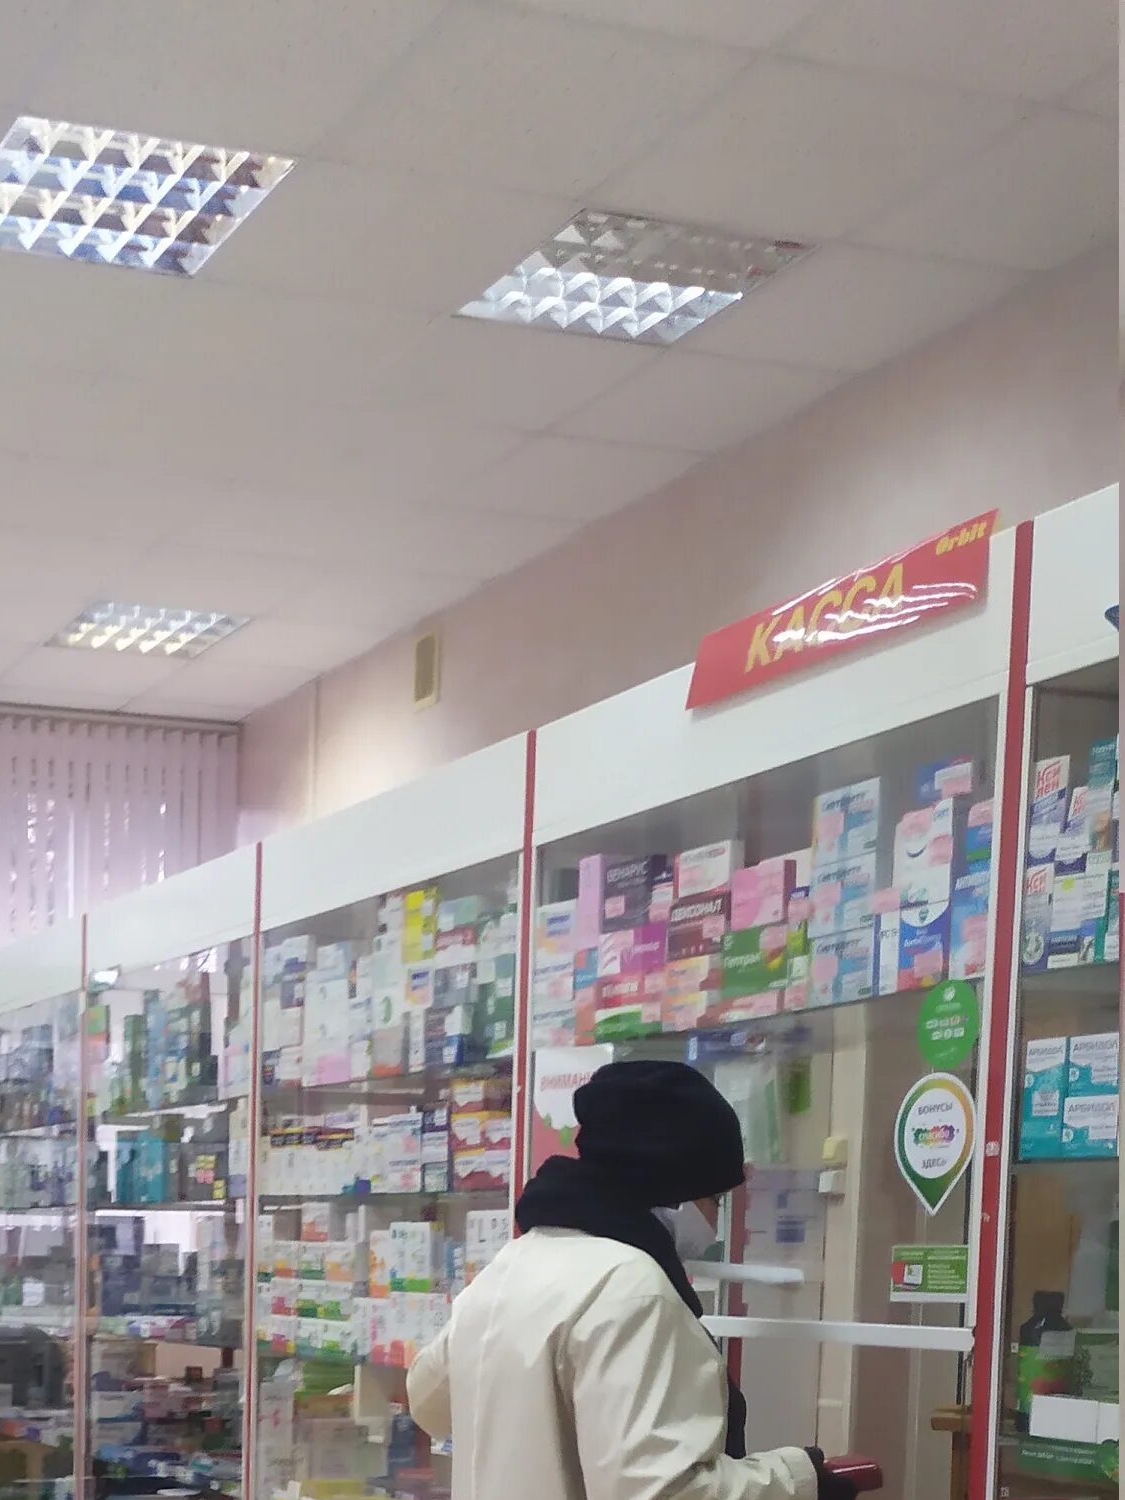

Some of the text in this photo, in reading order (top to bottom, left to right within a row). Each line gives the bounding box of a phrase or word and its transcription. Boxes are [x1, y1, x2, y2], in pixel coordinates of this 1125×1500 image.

[744, 562, 904, 675] КАССА
[918, 1103, 953, 1115] БОНУСЫ
[922, 1158, 947, 1169] ЗДЕСЬ
